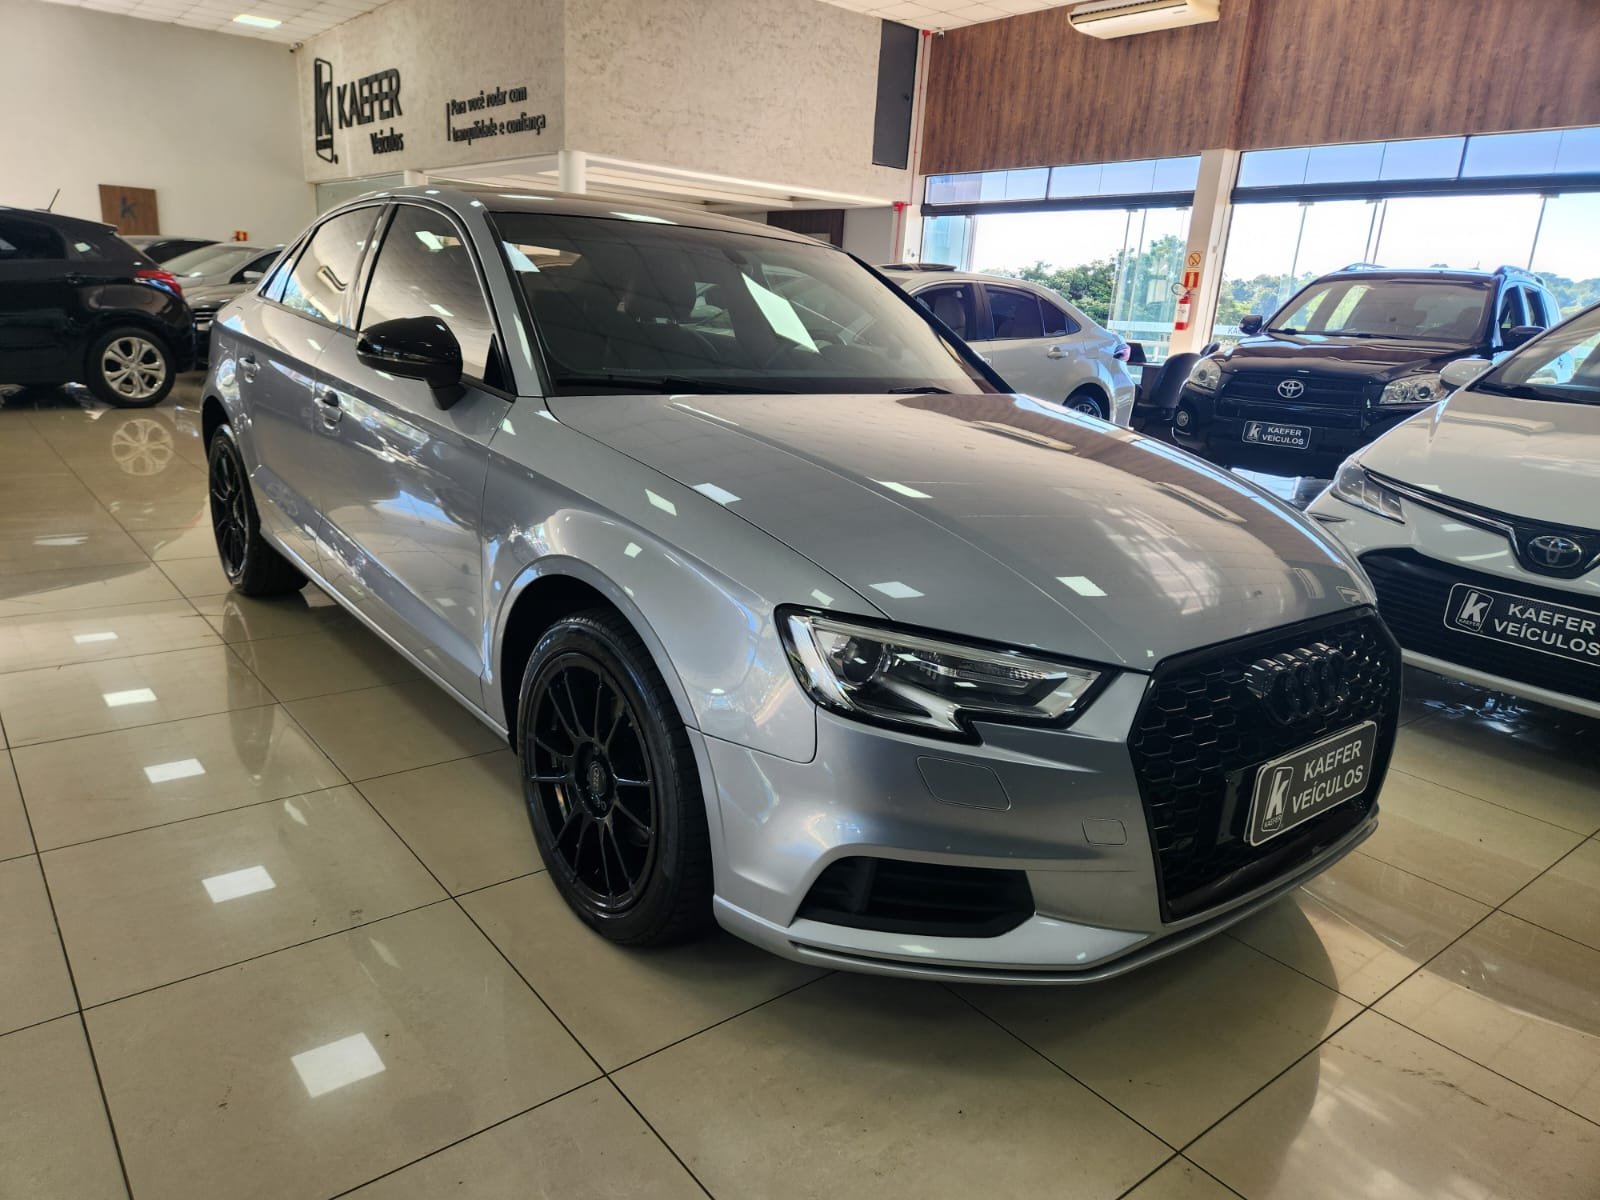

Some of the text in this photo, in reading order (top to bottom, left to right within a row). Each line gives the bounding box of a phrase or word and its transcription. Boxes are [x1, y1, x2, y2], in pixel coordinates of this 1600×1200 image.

[336, 68, 403, 130] KAEFER
[486, 86, 507, 108] rodar
[509, 87, 527, 103] com
[499, 121, 505, 135] e
[506, 112, 546, 136] confiança
[1267, 426, 1302, 437] KAEFER
[1493, 618, 1600, 657] VEÍCULOS
[1508, 603, 1597, 636] KAEFER
[1303, 740, 1362, 782] KAEFER
[1292, 764, 1364, 814] VEÍCULOS
